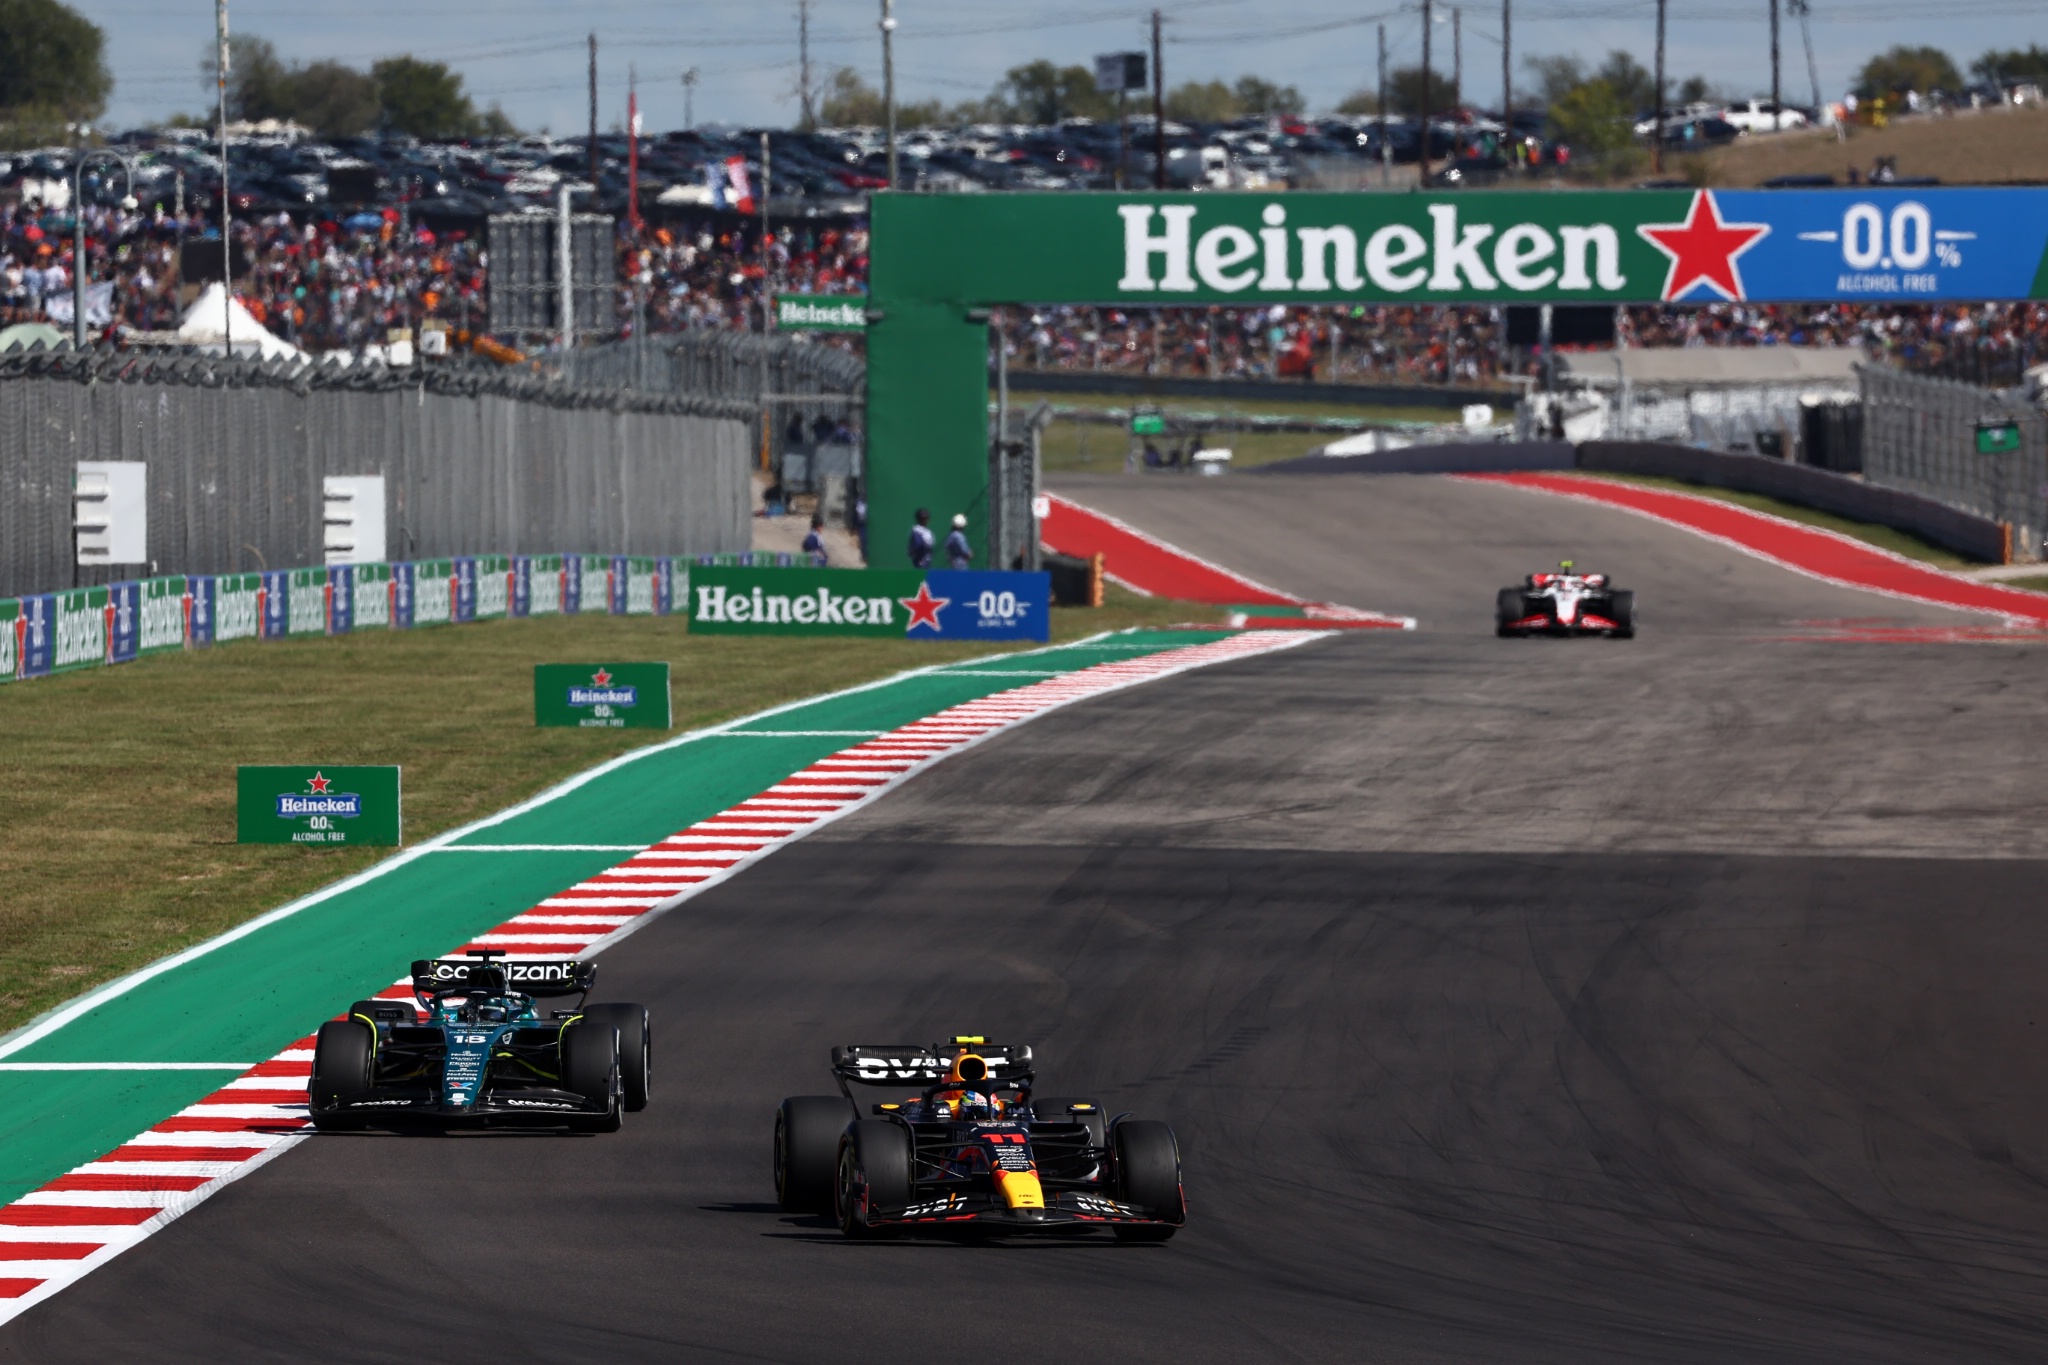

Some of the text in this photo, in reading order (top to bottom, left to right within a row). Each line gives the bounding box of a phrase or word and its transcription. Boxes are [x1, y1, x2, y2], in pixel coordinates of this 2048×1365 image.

[1118, 203, 1626, 292] Heineken
[1836, 274, 1938, 292] ALCOHOL FREE
[696, 586, 894, 625] Heineken
[56, 590, 104, 666] Heineken
[571, 690, 633, 703] Heineken
[281, 798, 356, 813] Heineken
[292, 832, 346, 842] ALCOHOL FREE
[436, 963, 571, 981] coizant
[454, 1035, 486, 1043] 18
[981, 1133, 1026, 1143] 11
